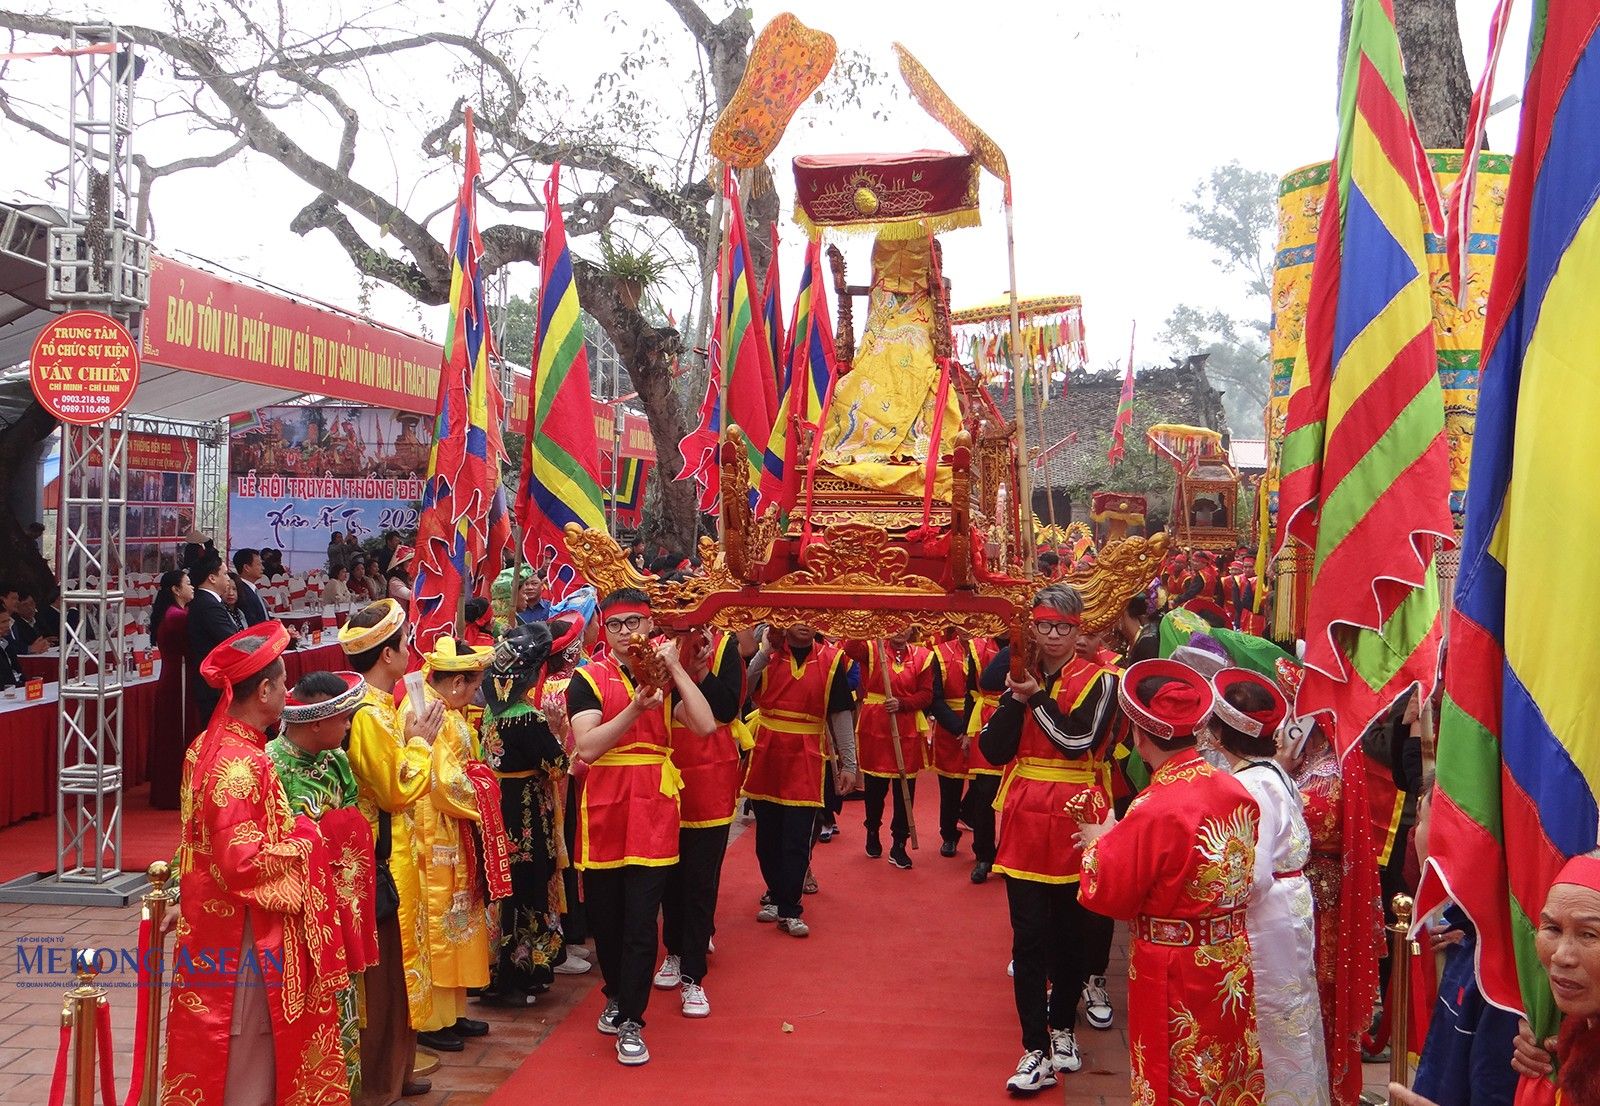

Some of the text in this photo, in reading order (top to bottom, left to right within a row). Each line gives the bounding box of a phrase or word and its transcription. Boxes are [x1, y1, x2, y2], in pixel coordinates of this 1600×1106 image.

[54, 325, 117, 340] TRUNG TÂM
[166, 278, 193, 348] BẢO
[197, 291, 222, 353] TỒN
[224, 304, 238, 358] VÀ
[241, 312, 270, 364] PHÁT
[271, 325, 293, 369] HUY
[293, 325, 310, 373] GIÁ
[312, 336, 327, 385] TRỊ
[328, 339, 338, 379] DI
[339, 329, 357, 384] SẢN
[359, 342, 375, 387] VĂN
[376, 348, 392, 391] HÓA
[393, 352, 402, 393] LÀ
[403, 356, 426, 398] TRÁCH
[41, 337, 129, 360] TỔ CHỨC SỰ KIỆN
[39, 359, 131, 383] VẤN CHIẾN
[49, 383, 61, 391] CHÍ
[63, 384, 82, 392] MINH
[89, 383, 101, 392] CHÍ
[103, 384, 120, 393] LINH
[61, 395, 110, 404] 0903.218.958
[61, 404, 110, 414] 0989.110.490
[238, 470, 425, 501] LỄ HỘI TRUYỀN THỐNG ĐỀN
[267, 503, 310, 549] Xuân
[377, 508, 420, 530] 202
